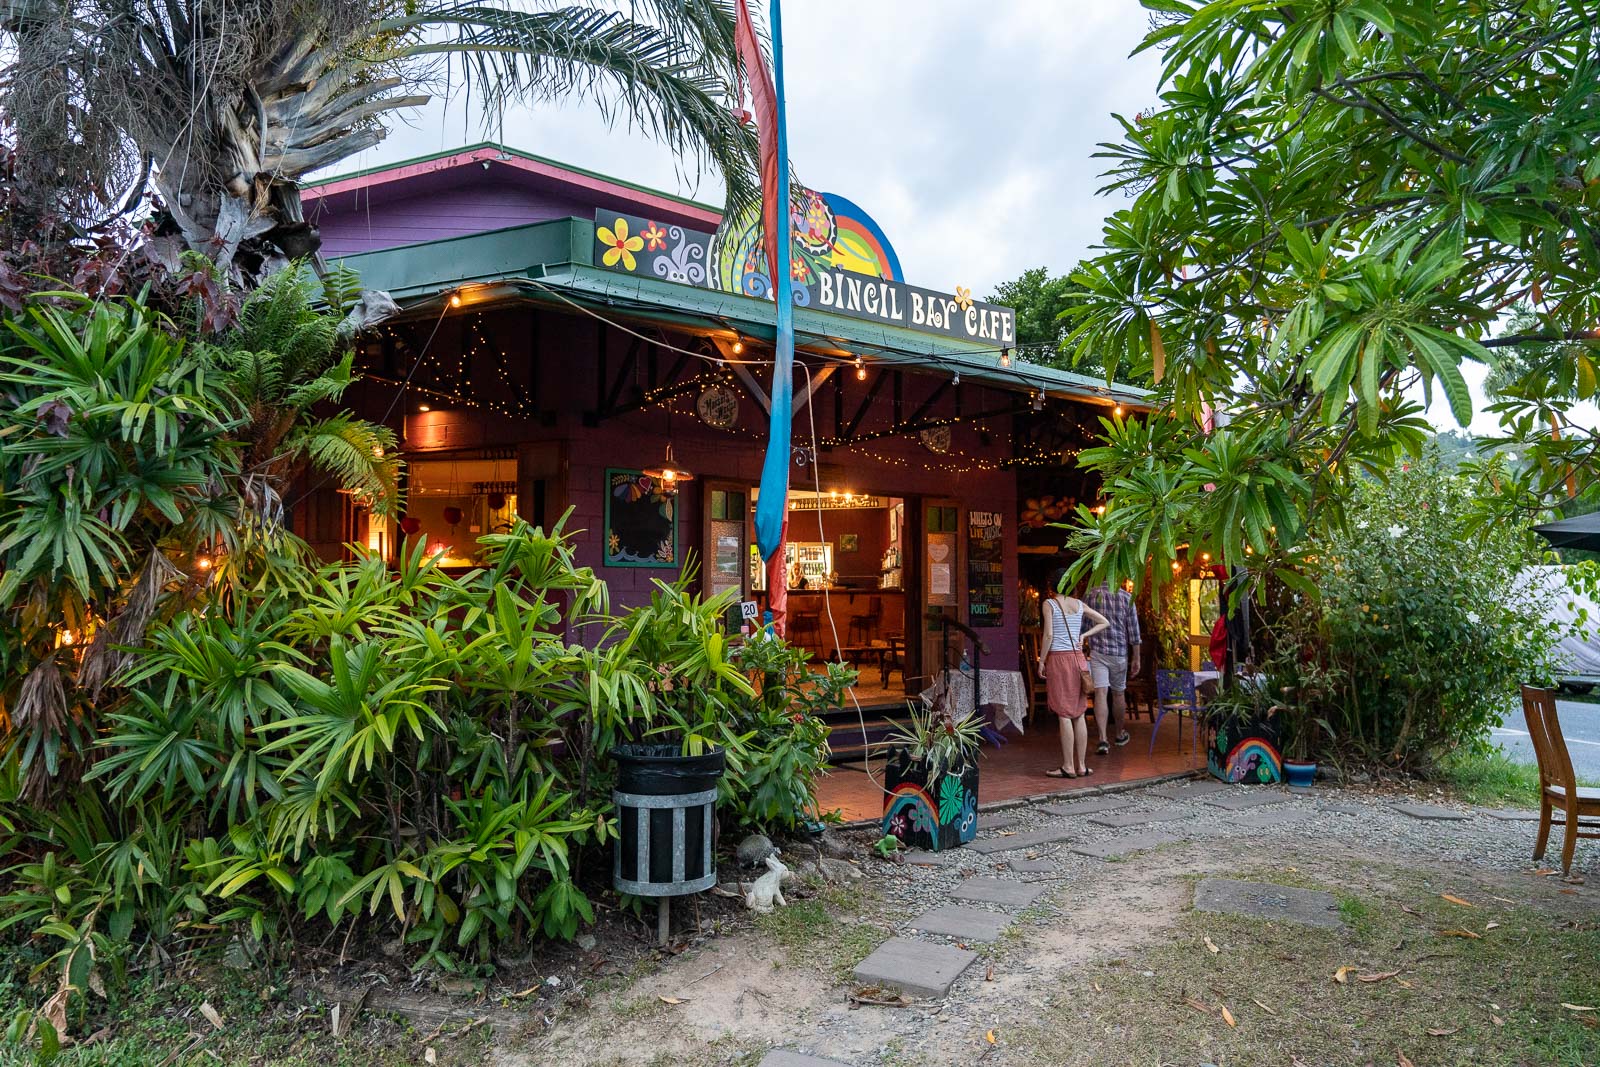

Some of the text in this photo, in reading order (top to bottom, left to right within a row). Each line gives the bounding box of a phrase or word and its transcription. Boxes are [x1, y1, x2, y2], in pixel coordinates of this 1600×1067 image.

[818, 272, 1013, 342] BINGIL BAY CAFE
[743, 603, 756, 616] 20
